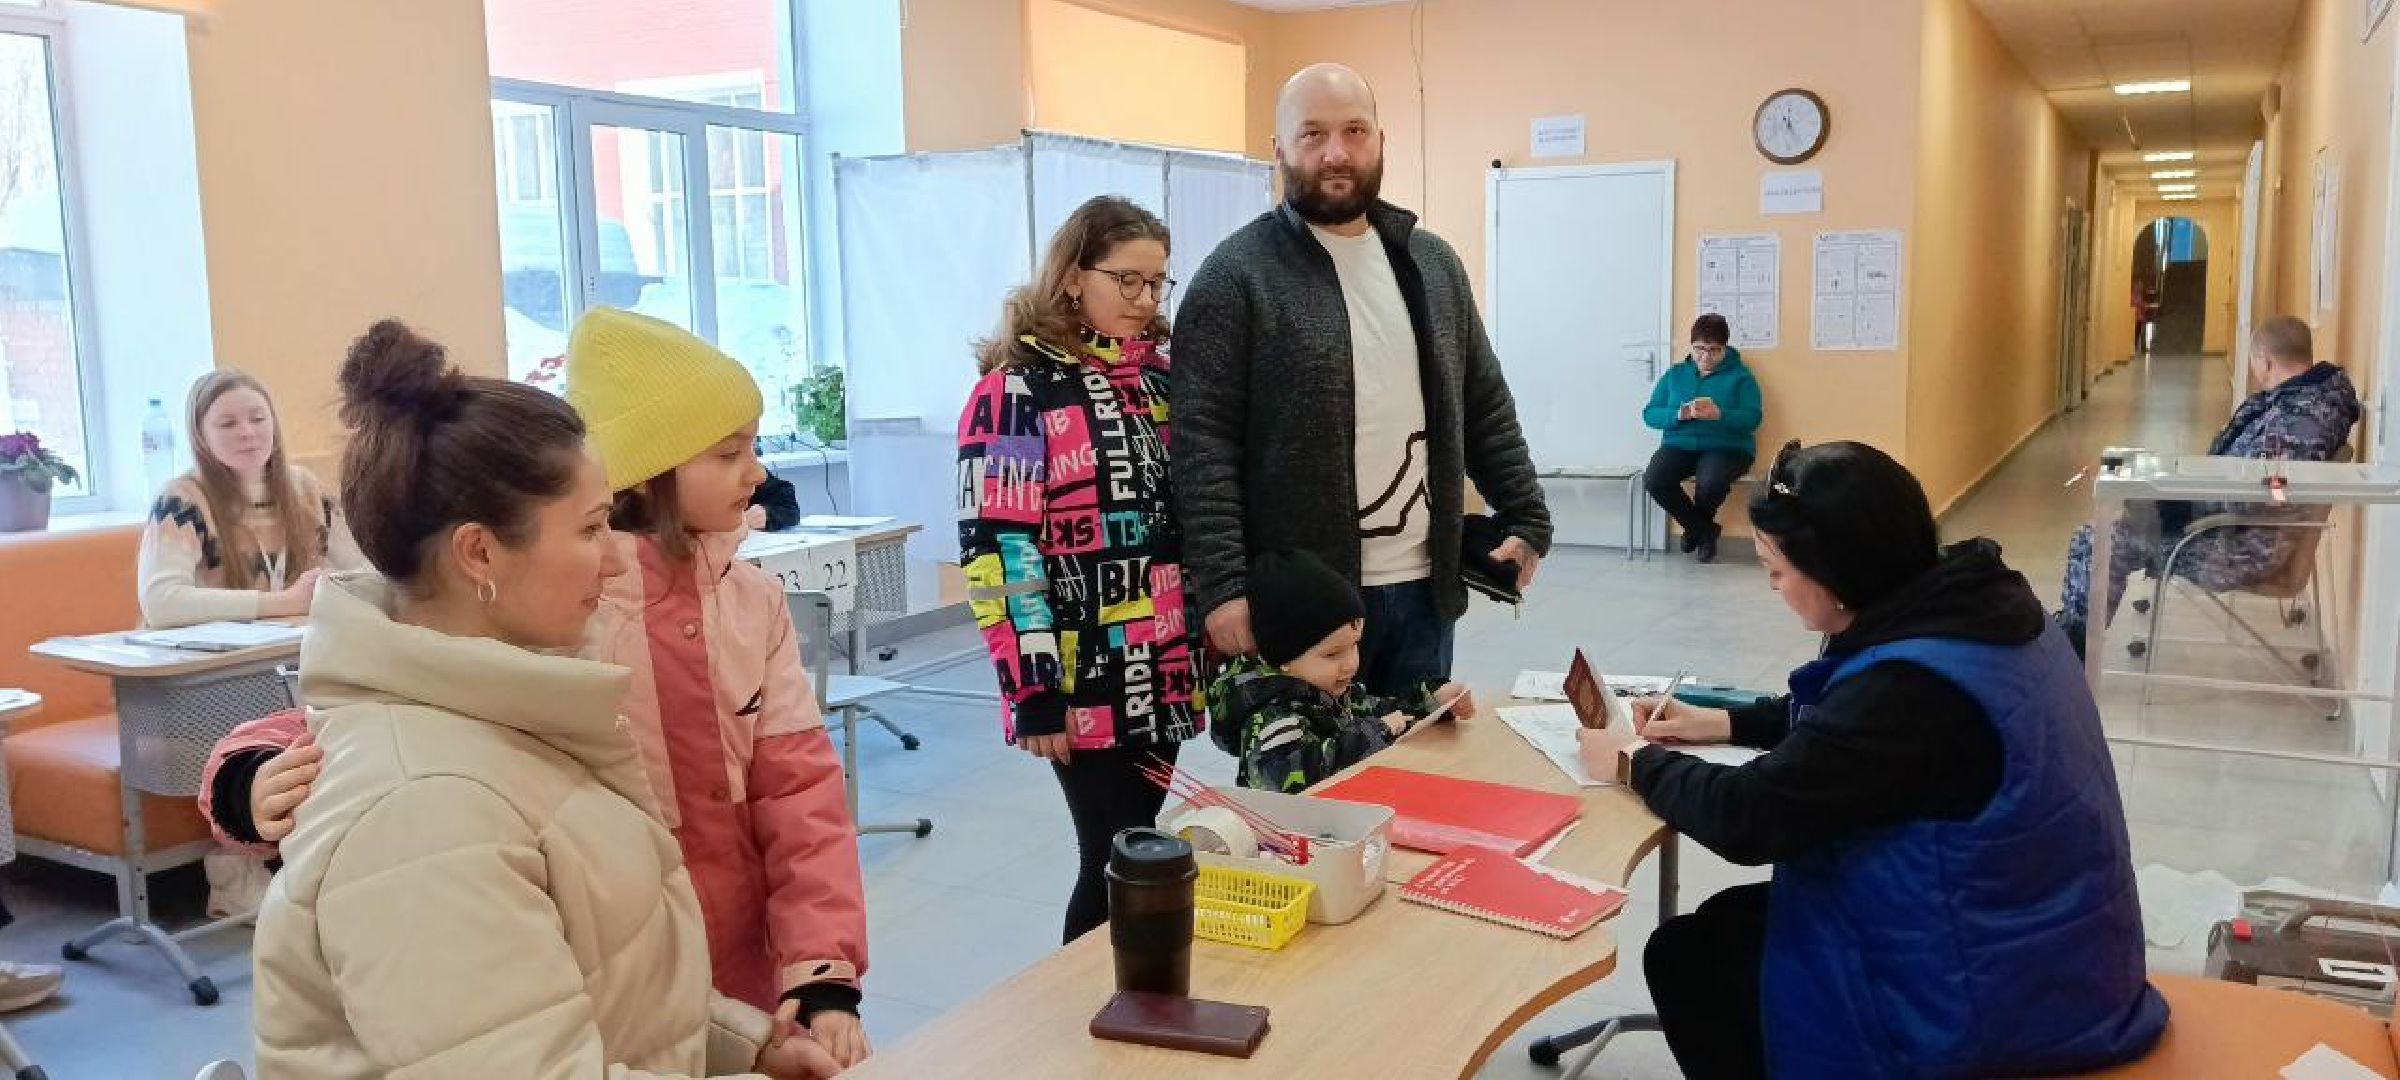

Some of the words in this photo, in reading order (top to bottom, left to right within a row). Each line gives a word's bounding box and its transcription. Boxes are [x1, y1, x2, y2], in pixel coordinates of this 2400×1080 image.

[967, 394, 1041, 437] AIR
[1082, 368, 1137, 501] FULLRID
[1048, 442, 1099, 485] ING
[823, 560, 848, 591] 22
[1123, 640, 1158, 743] LRIDE
